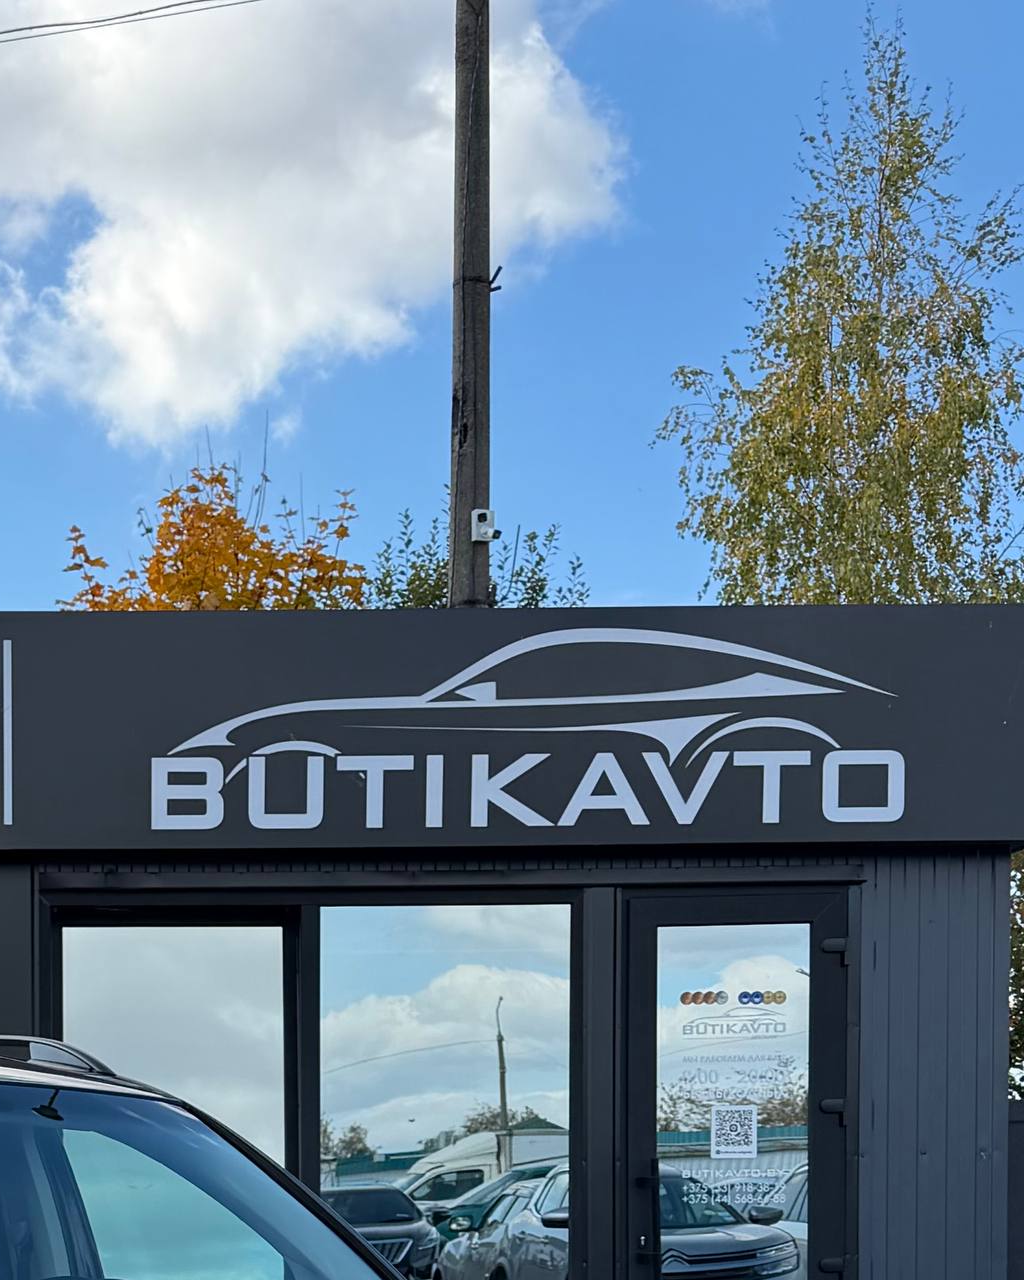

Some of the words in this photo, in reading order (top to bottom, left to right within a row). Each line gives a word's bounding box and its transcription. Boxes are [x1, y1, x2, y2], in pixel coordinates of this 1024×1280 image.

[150, 748, 907, 831] BUTIKAVTO
[682, 1022, 787, 1036] BUTIKAVTO
[682, 1183, 708, 1193] +375
[682, 1194, 708, 1204] +375
